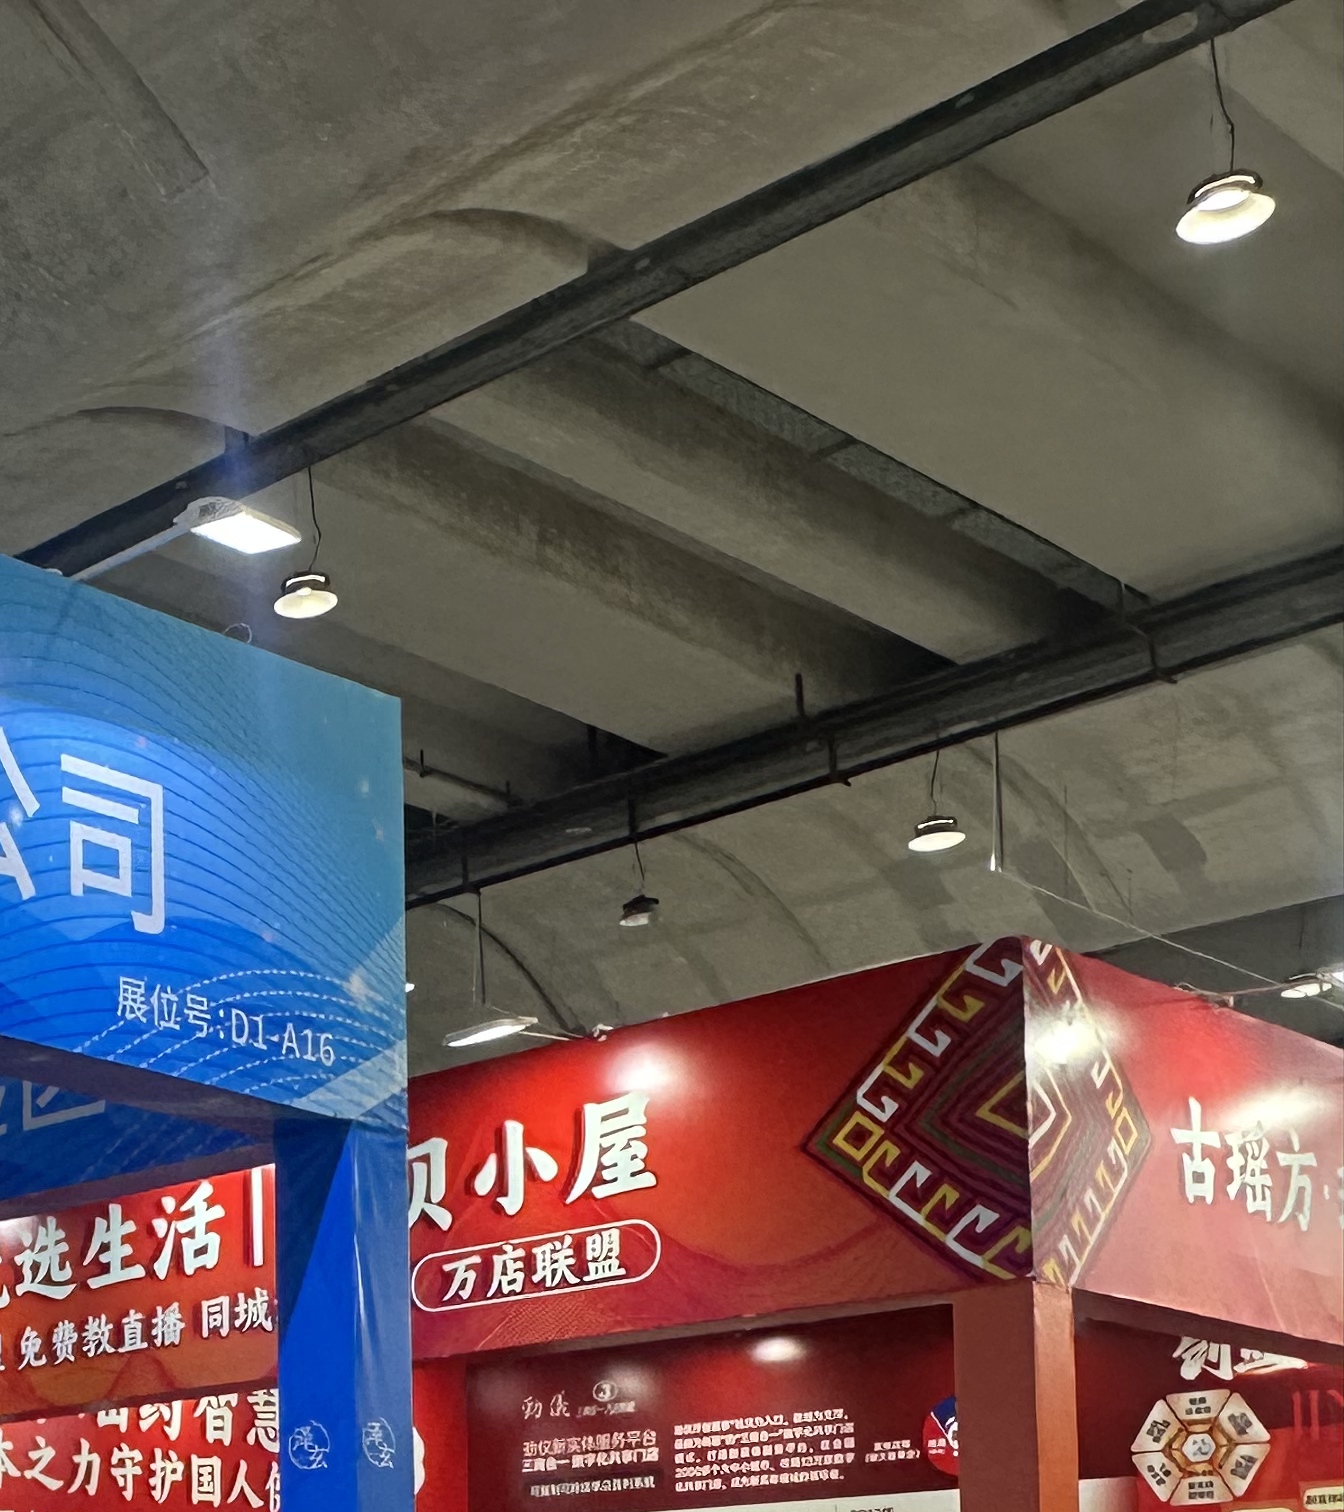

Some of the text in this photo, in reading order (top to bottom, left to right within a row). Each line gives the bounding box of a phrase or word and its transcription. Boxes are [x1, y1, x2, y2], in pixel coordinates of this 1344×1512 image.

[1169, 1095, 1344, 1232] 古瑶方·
[441, 1227, 627, 1303] 万店联盟
[17, 1301, 187, 1370] 免费教直播
